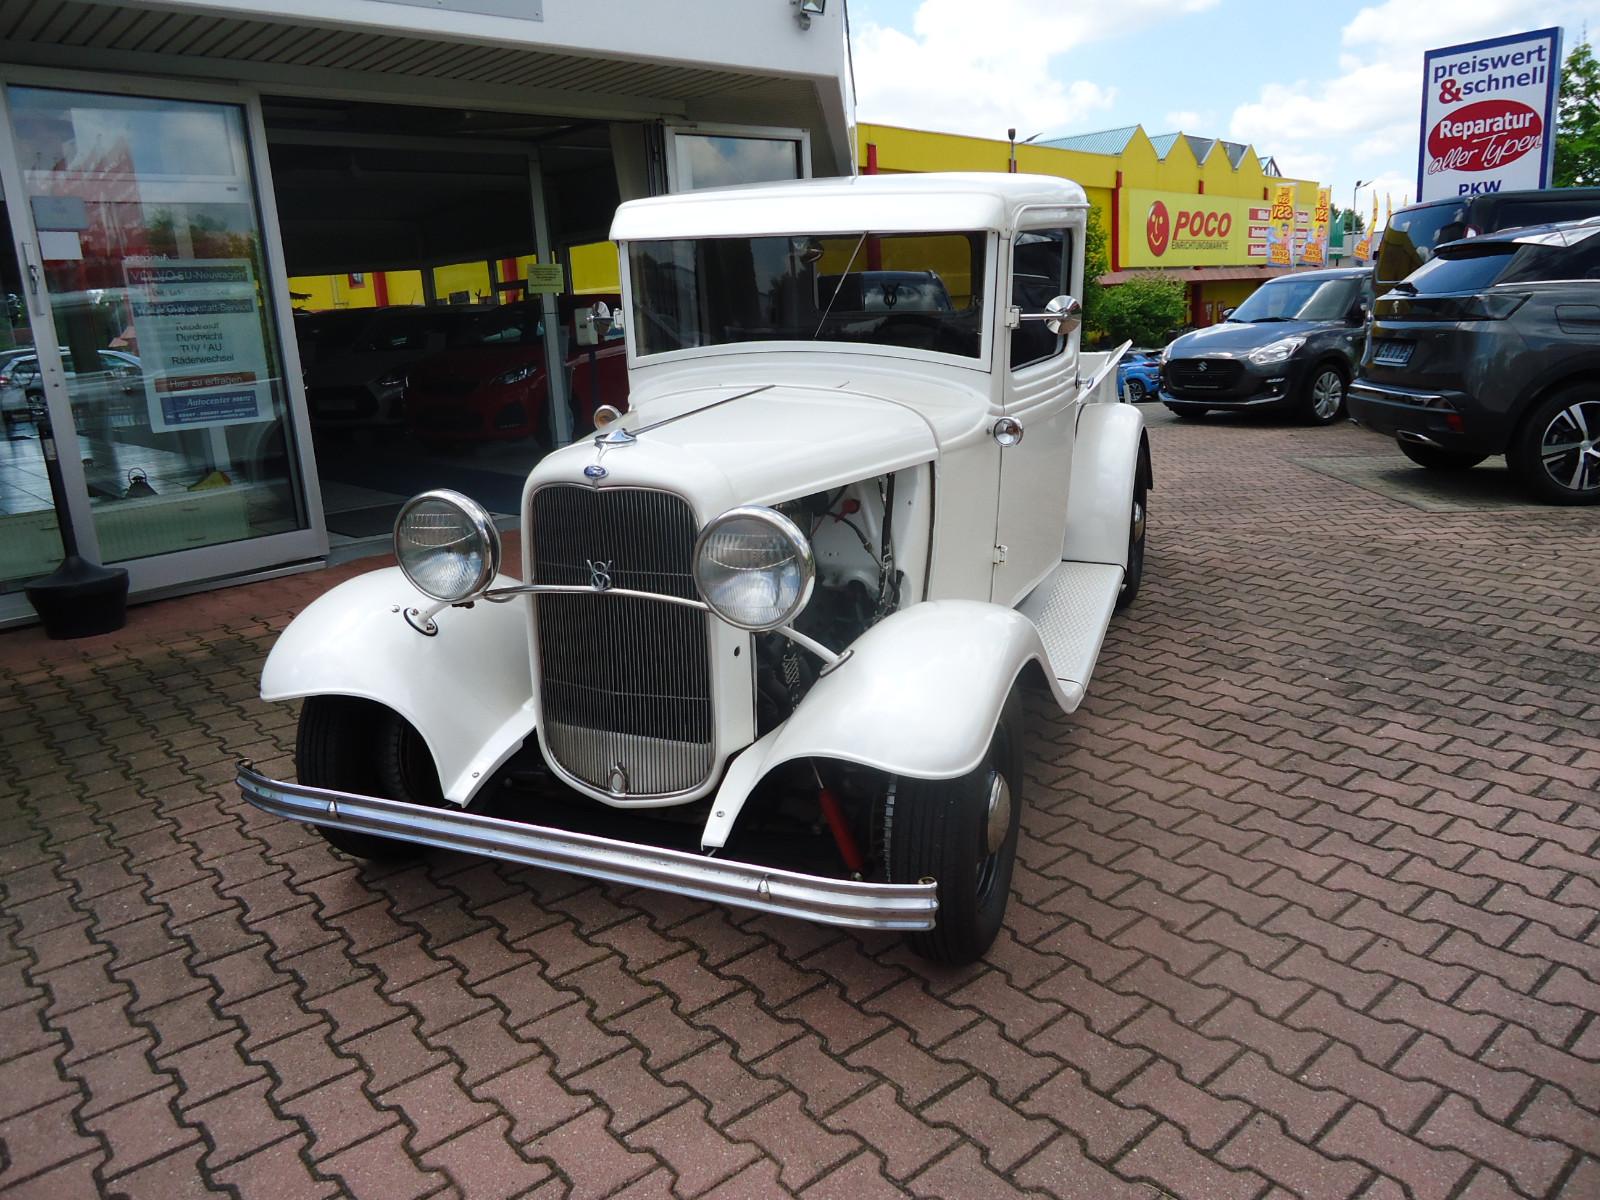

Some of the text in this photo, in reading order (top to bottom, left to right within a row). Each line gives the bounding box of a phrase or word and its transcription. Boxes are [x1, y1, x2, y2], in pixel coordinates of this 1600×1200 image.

[1433, 45, 1547, 84] preiswert
[1438, 111, 1535, 140] Reparatur
[1428, 132, 1542, 175] aller Typen
[1458, 179, 1502, 196] PKW
[1172, 210, 1232, 240] POCO
[208, 343, 222, 352] AU
[186, 396, 230, 407] Autocenter
[586, 559, 613, 591] V8
